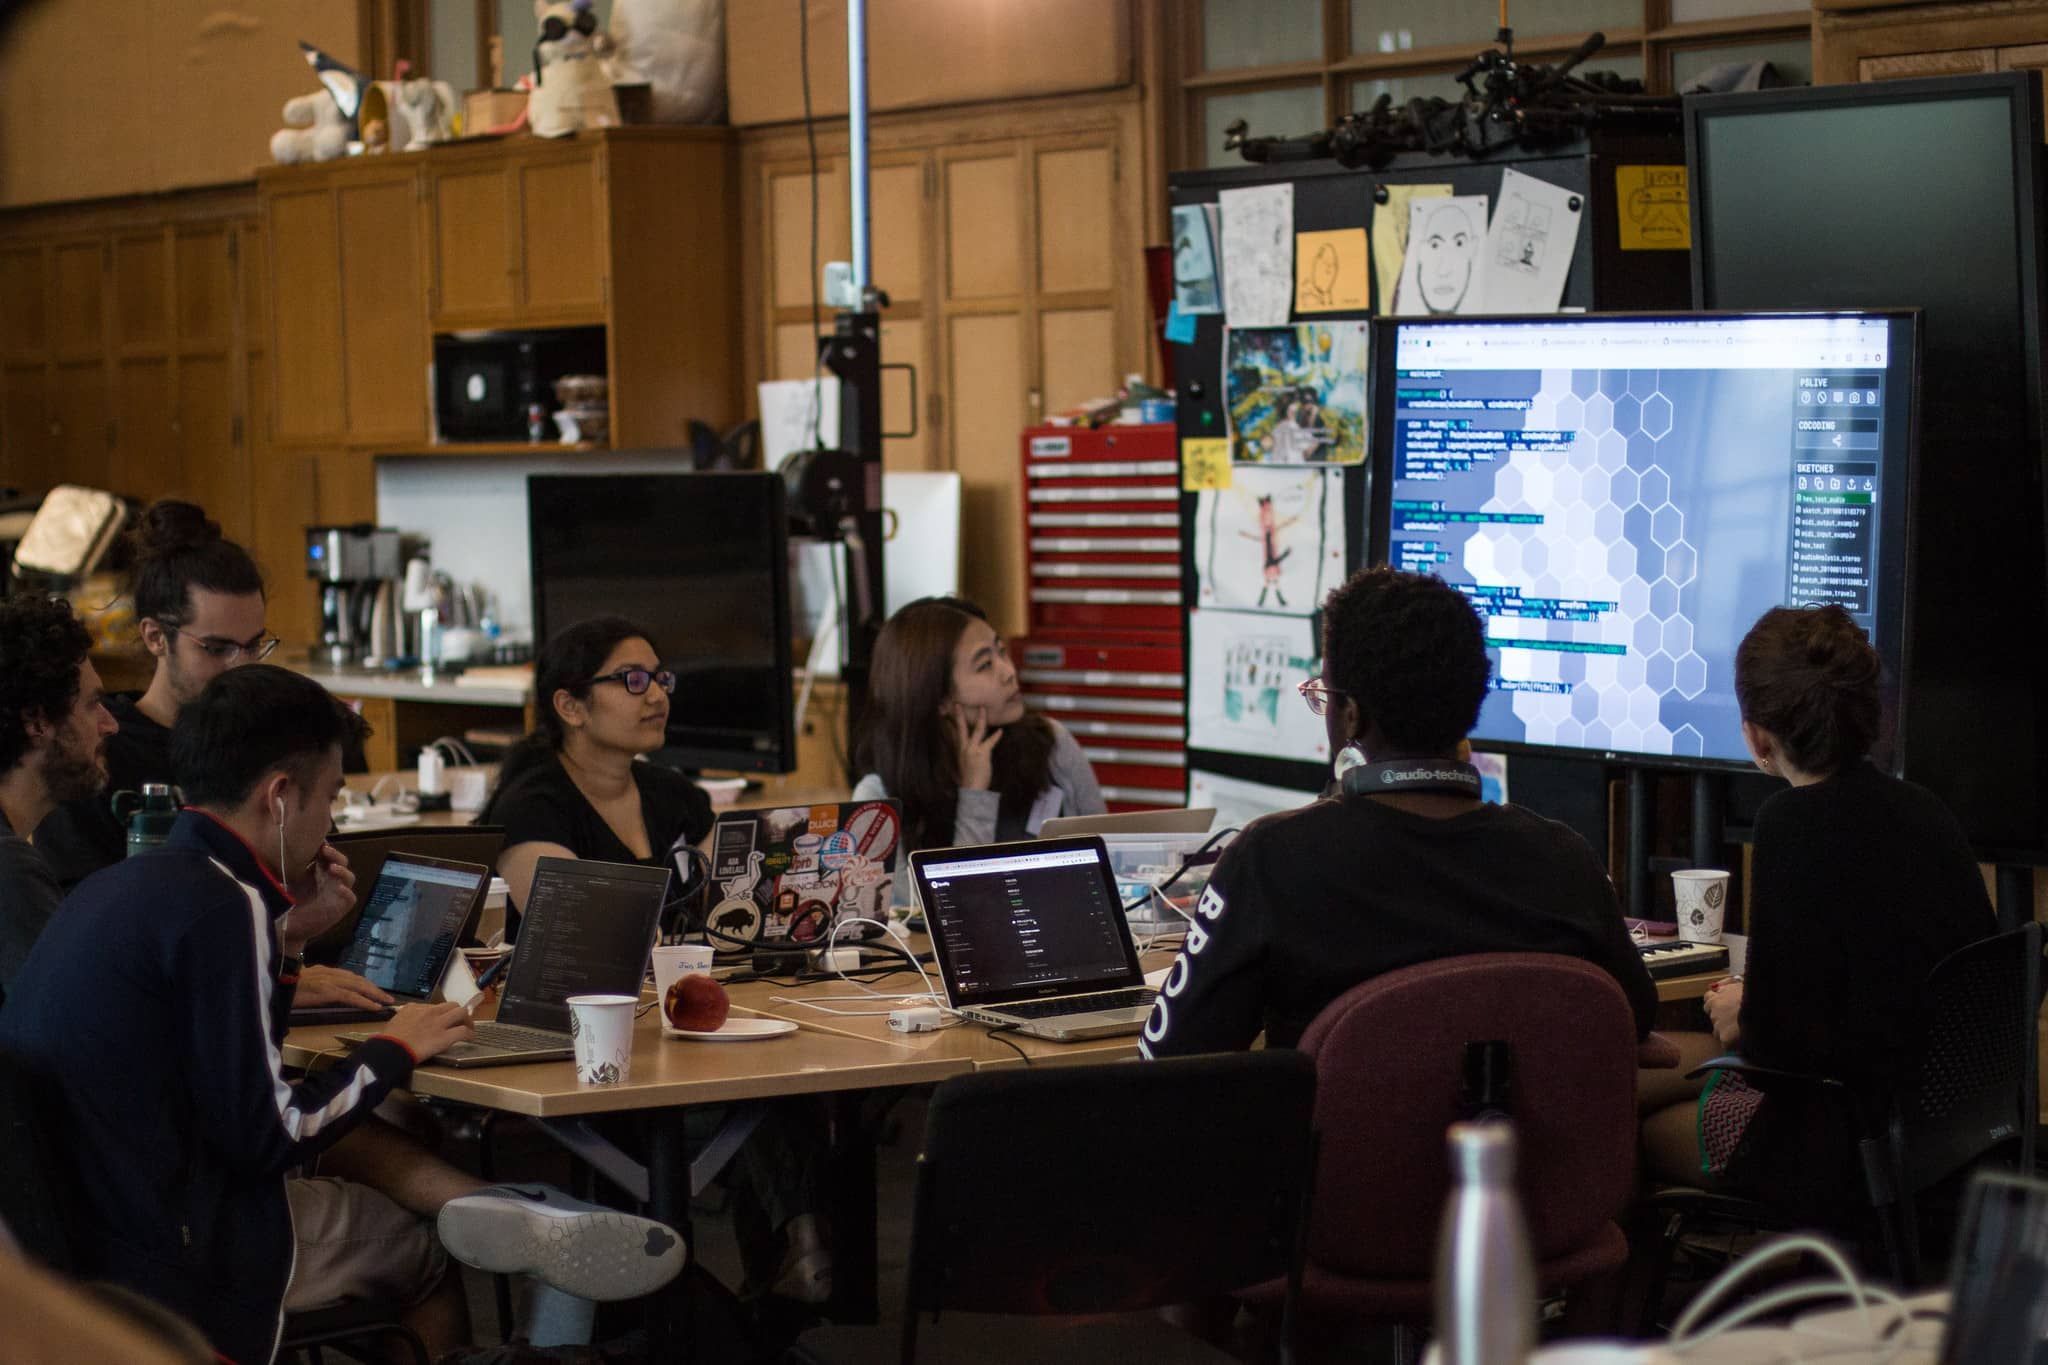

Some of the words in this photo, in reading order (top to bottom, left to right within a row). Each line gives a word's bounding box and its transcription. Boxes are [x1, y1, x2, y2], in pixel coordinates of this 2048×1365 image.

[1798, 421, 1836, 431] COCODING
[1797, 463, 1834, 474] SKETCHES
[781, 880, 839, 890] PRINCETON
